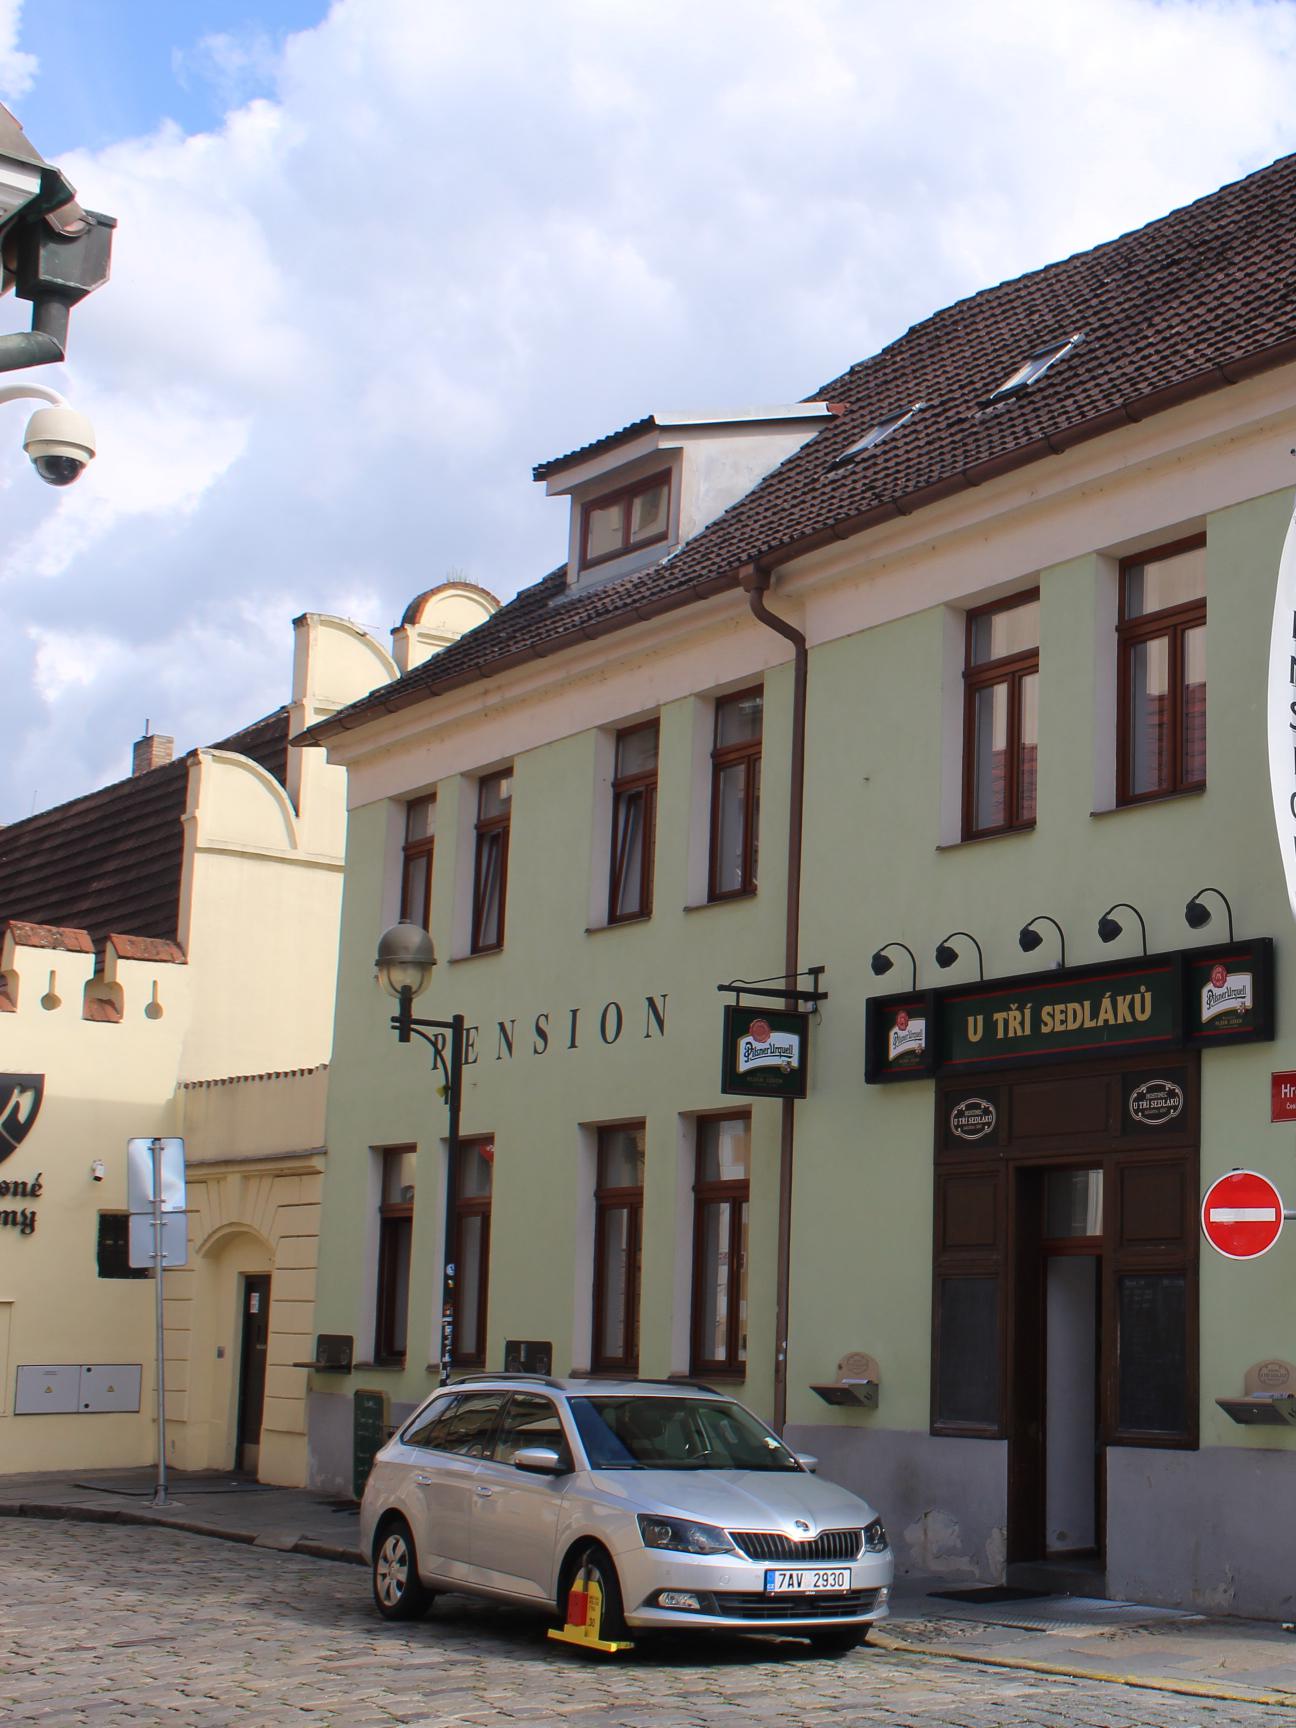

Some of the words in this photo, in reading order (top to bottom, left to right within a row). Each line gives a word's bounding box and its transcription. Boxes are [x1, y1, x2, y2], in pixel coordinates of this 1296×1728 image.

[431, 994, 668, 1070] PENSION
[967, 1014, 984, 1043] U
[993, 1003, 1032, 1039] TŘÍ
[1041, 985, 1152, 1034] SEDLÁKŮ
[778, 1573, 803, 1589] 7AV
[813, 1572, 845, 1588] 2930
